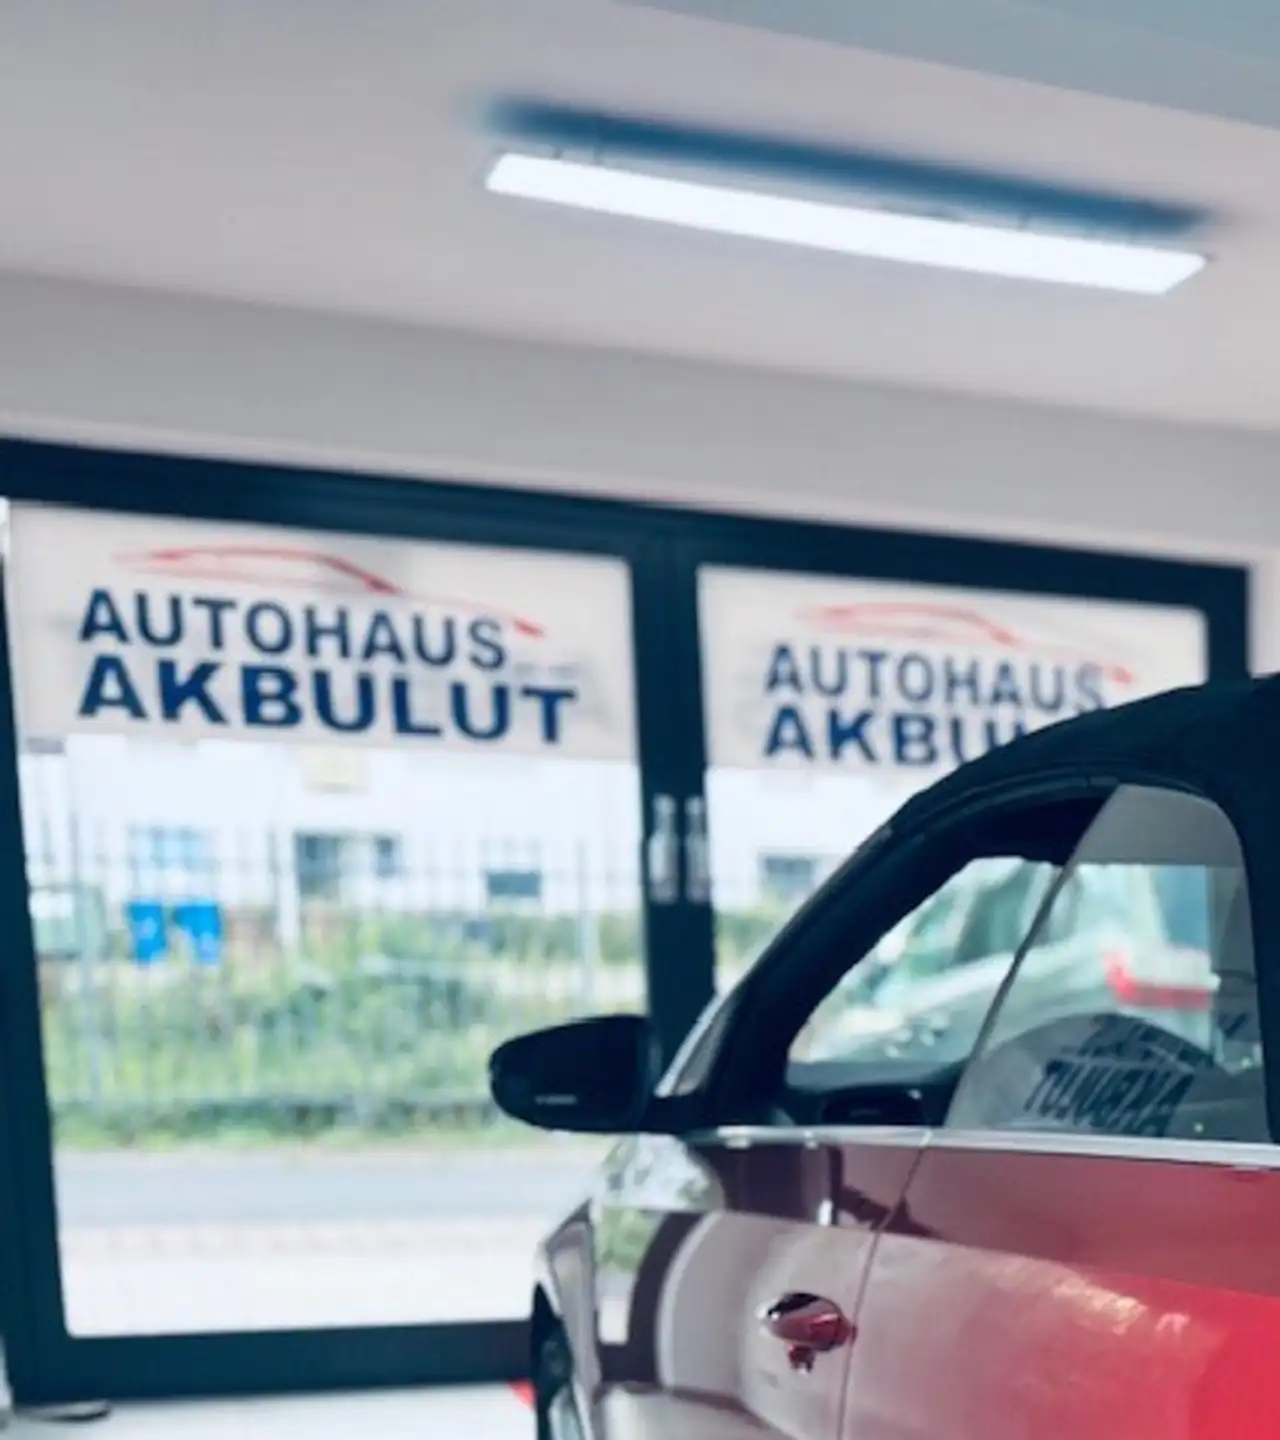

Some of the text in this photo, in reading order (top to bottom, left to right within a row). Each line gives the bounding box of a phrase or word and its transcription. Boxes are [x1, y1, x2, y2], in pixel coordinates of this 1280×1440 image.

[79, 587, 508, 671] AUTOHAUS
[77, 653, 579, 744] AKBULUT
[765, 644, 1106, 714] AUTOHAUS
